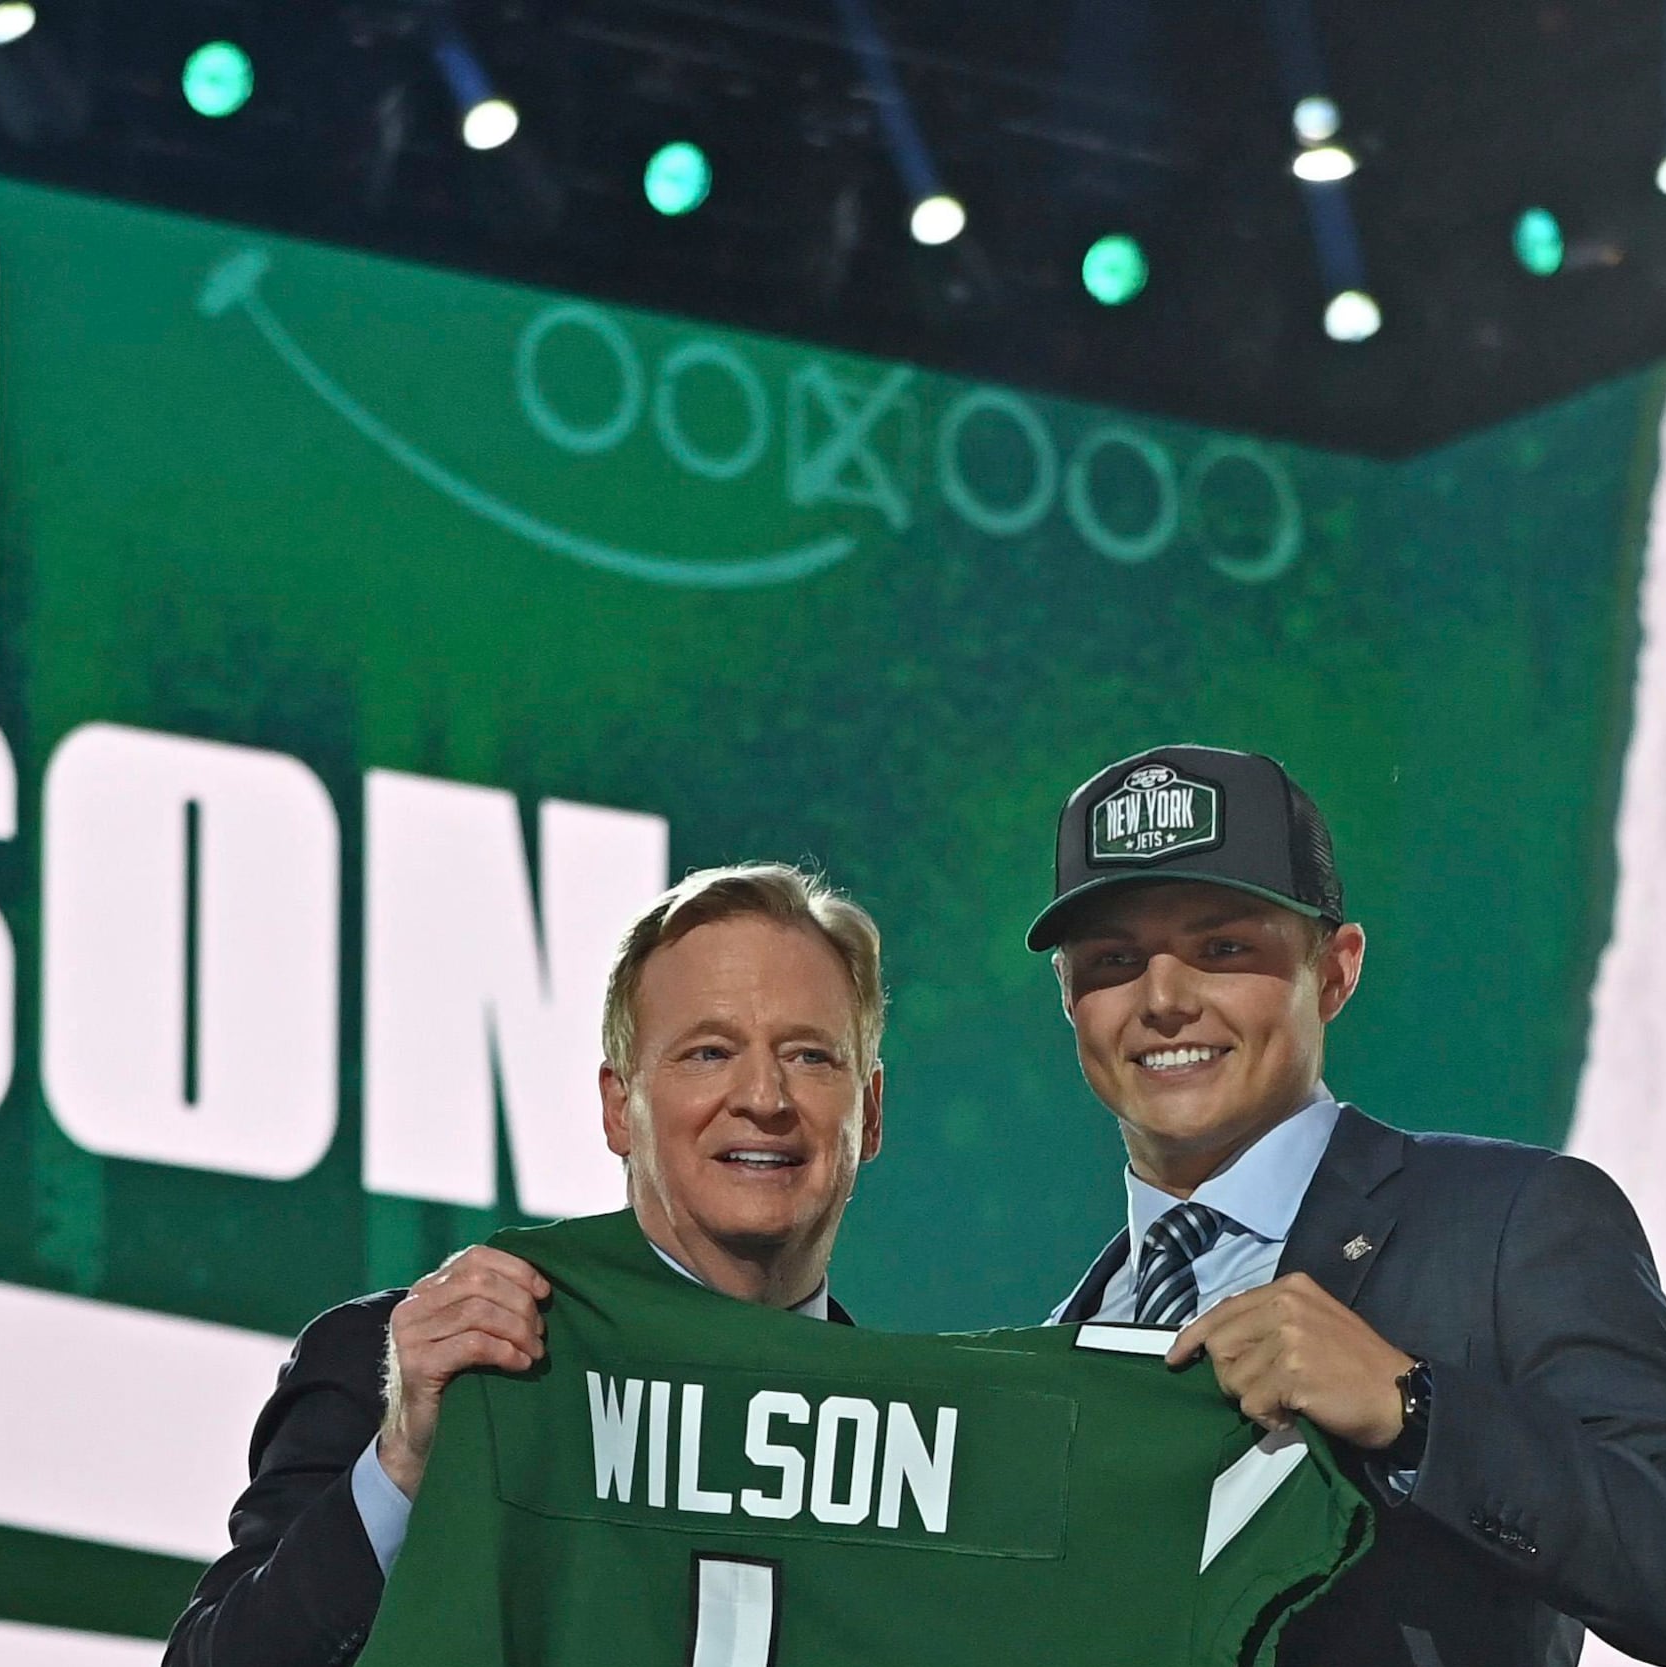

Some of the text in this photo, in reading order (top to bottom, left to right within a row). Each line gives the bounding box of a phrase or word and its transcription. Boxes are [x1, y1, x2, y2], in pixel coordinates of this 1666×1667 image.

[1106, 788, 1194, 842] NEW YORK
[1135, 830, 1163, 851] JETS
[585, 1370, 958, 1533] WILSON
